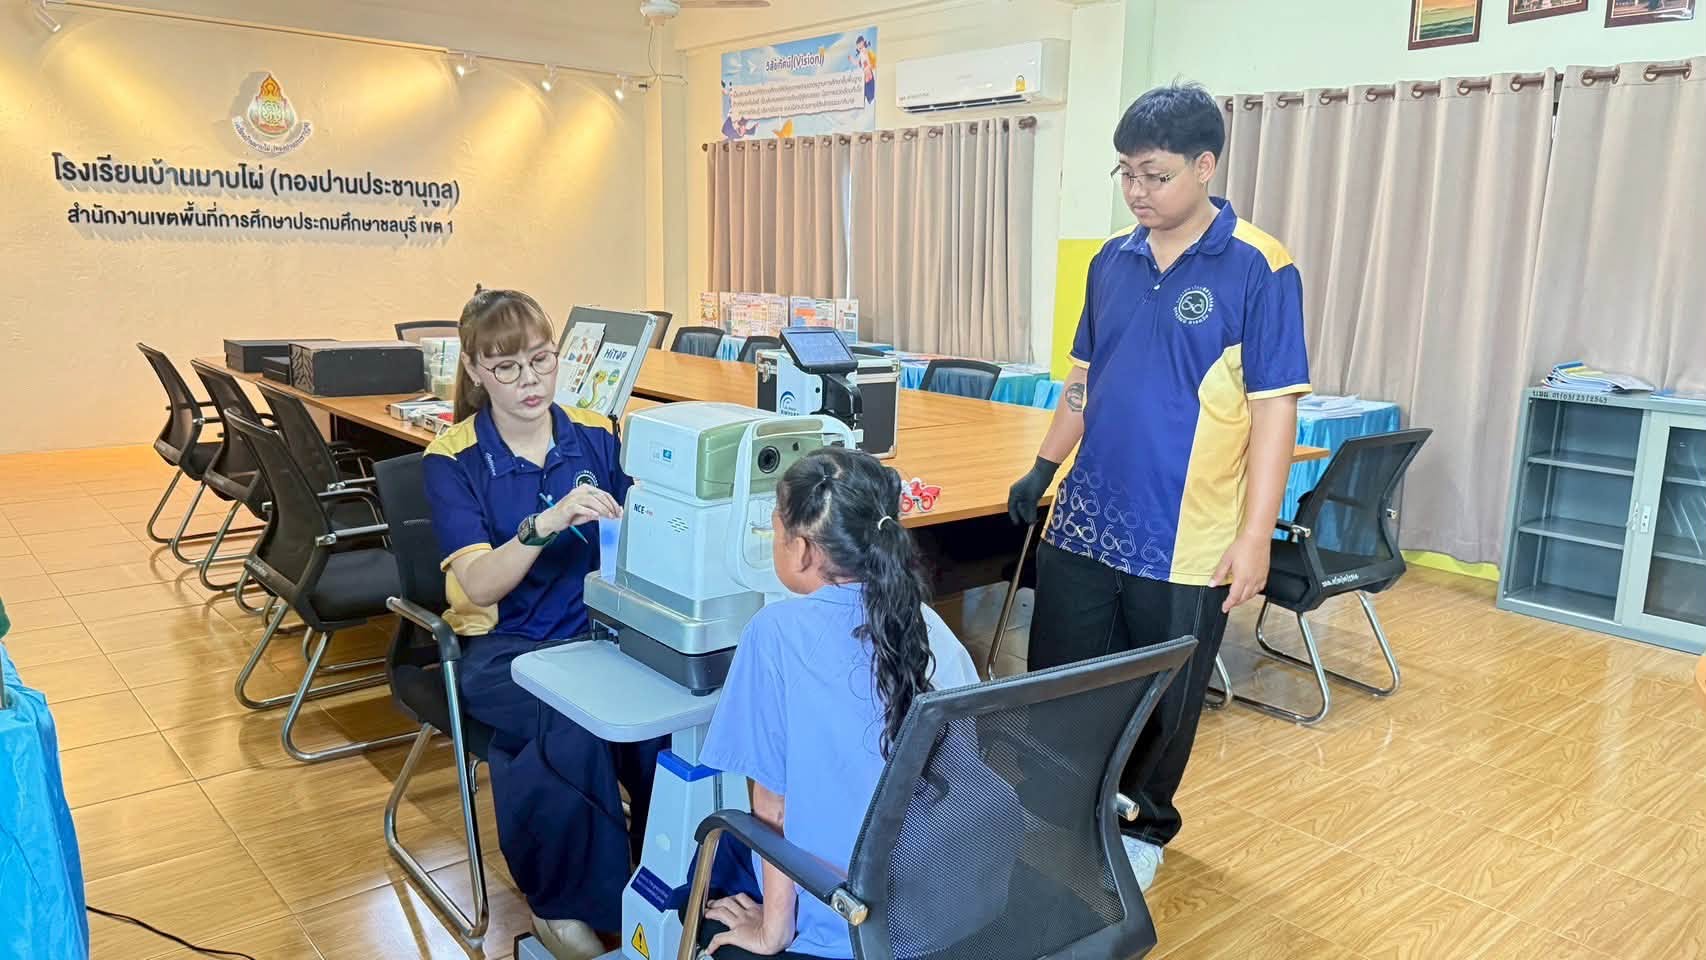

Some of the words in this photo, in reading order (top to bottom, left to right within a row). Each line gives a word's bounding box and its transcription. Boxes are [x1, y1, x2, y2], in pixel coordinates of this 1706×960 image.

[51, 152, 264, 190] โรงเรียนบ้านมาบไผ่
[270, 168, 460, 207] (ทองปานประชานุกูล)
[67, 202, 417, 239] สำนักงานเขตพื้นที่การศึกษาประถมศึกษาชลบุรี
[421, 220, 443, 234] เขต
[447, 220, 453, 234] 1
[633, 503, 645, 514] NCE
